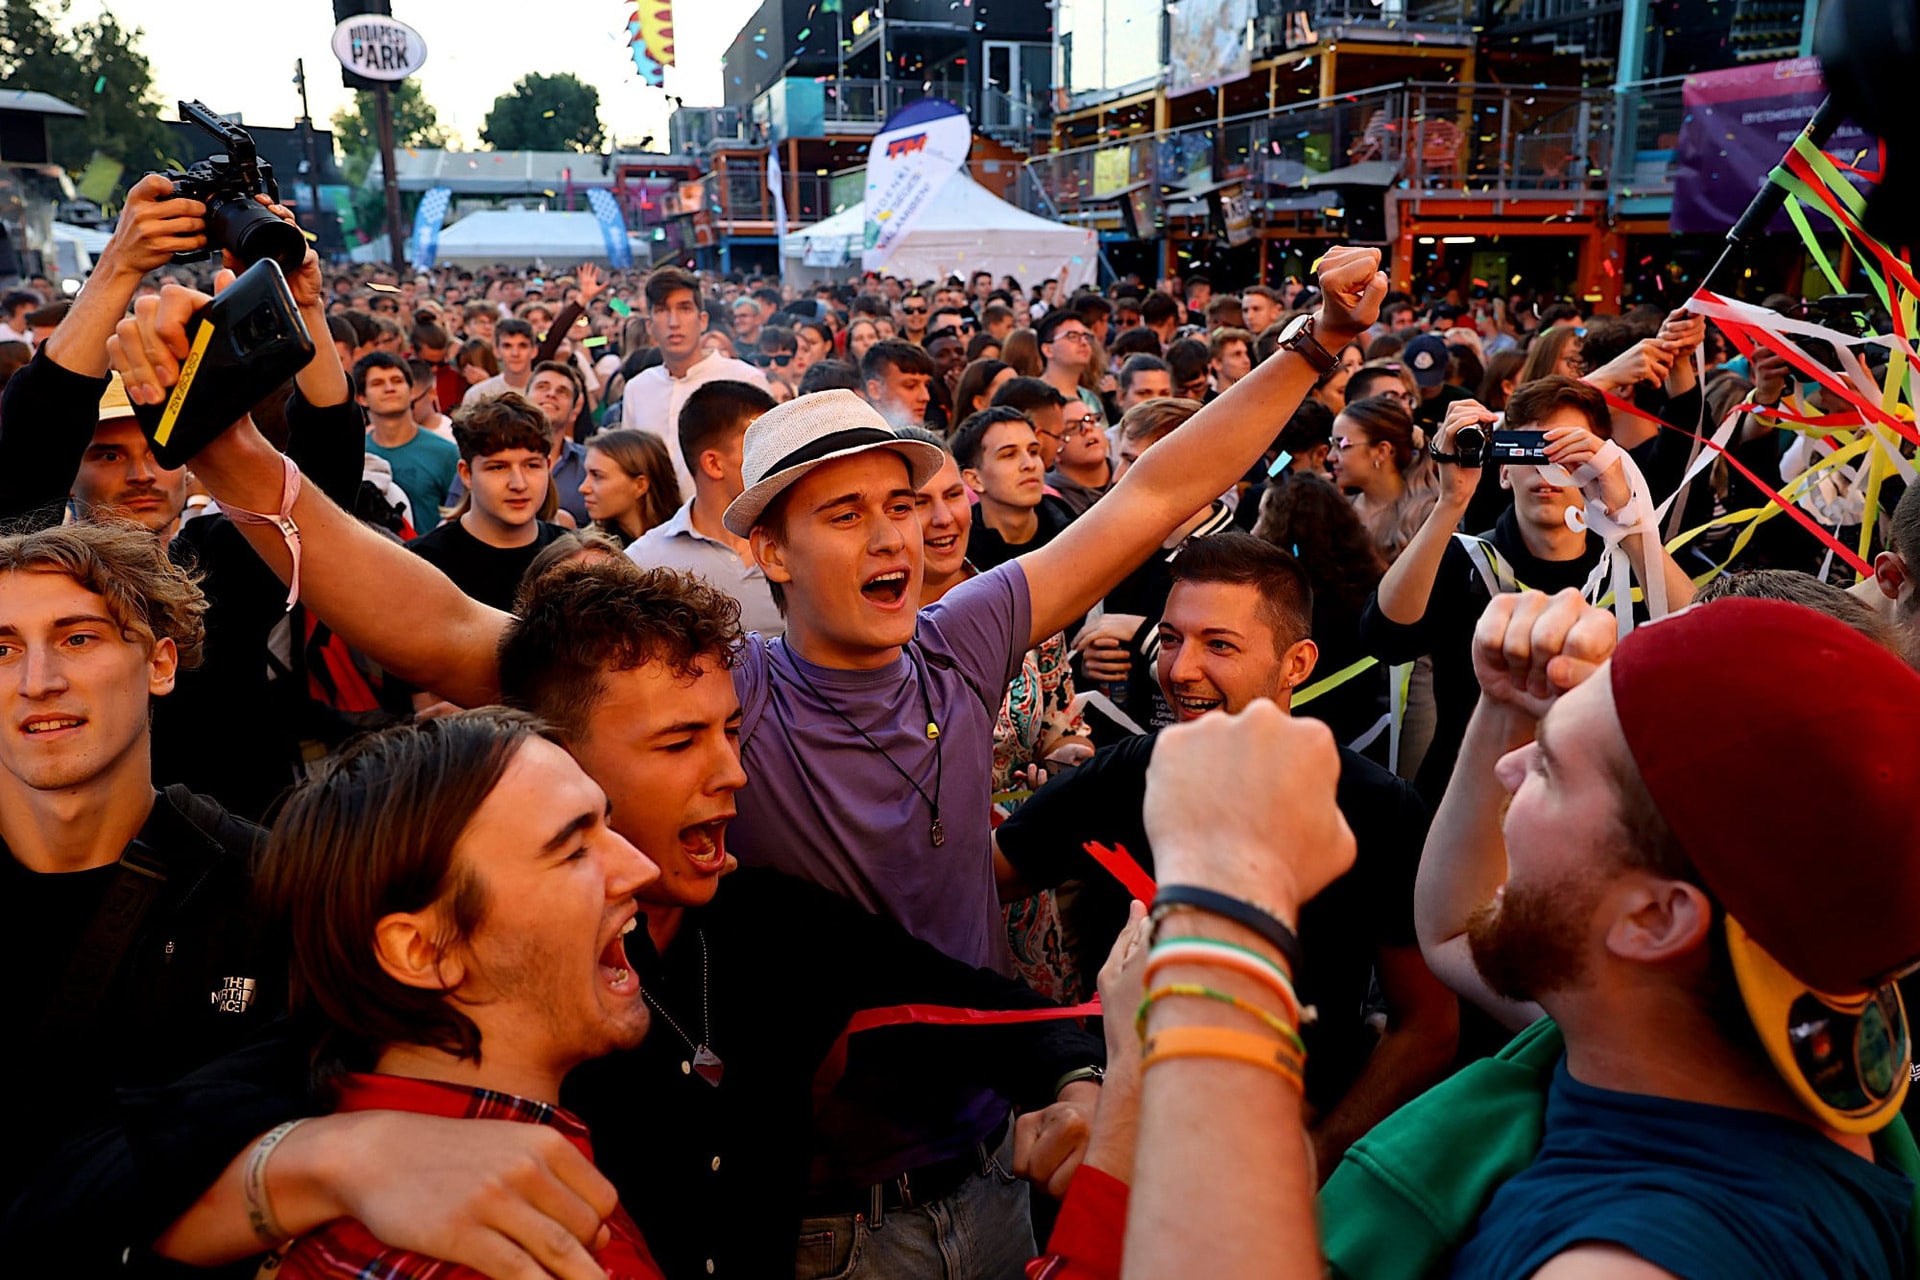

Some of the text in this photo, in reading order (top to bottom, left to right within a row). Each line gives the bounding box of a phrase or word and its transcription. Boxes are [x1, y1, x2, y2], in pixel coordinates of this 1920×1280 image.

[352, 44, 409, 69] PARK
[223, 976, 243, 989] THE
[211, 988, 241, 1004] NRTH
[219, 999, 241, 1013] ACE
